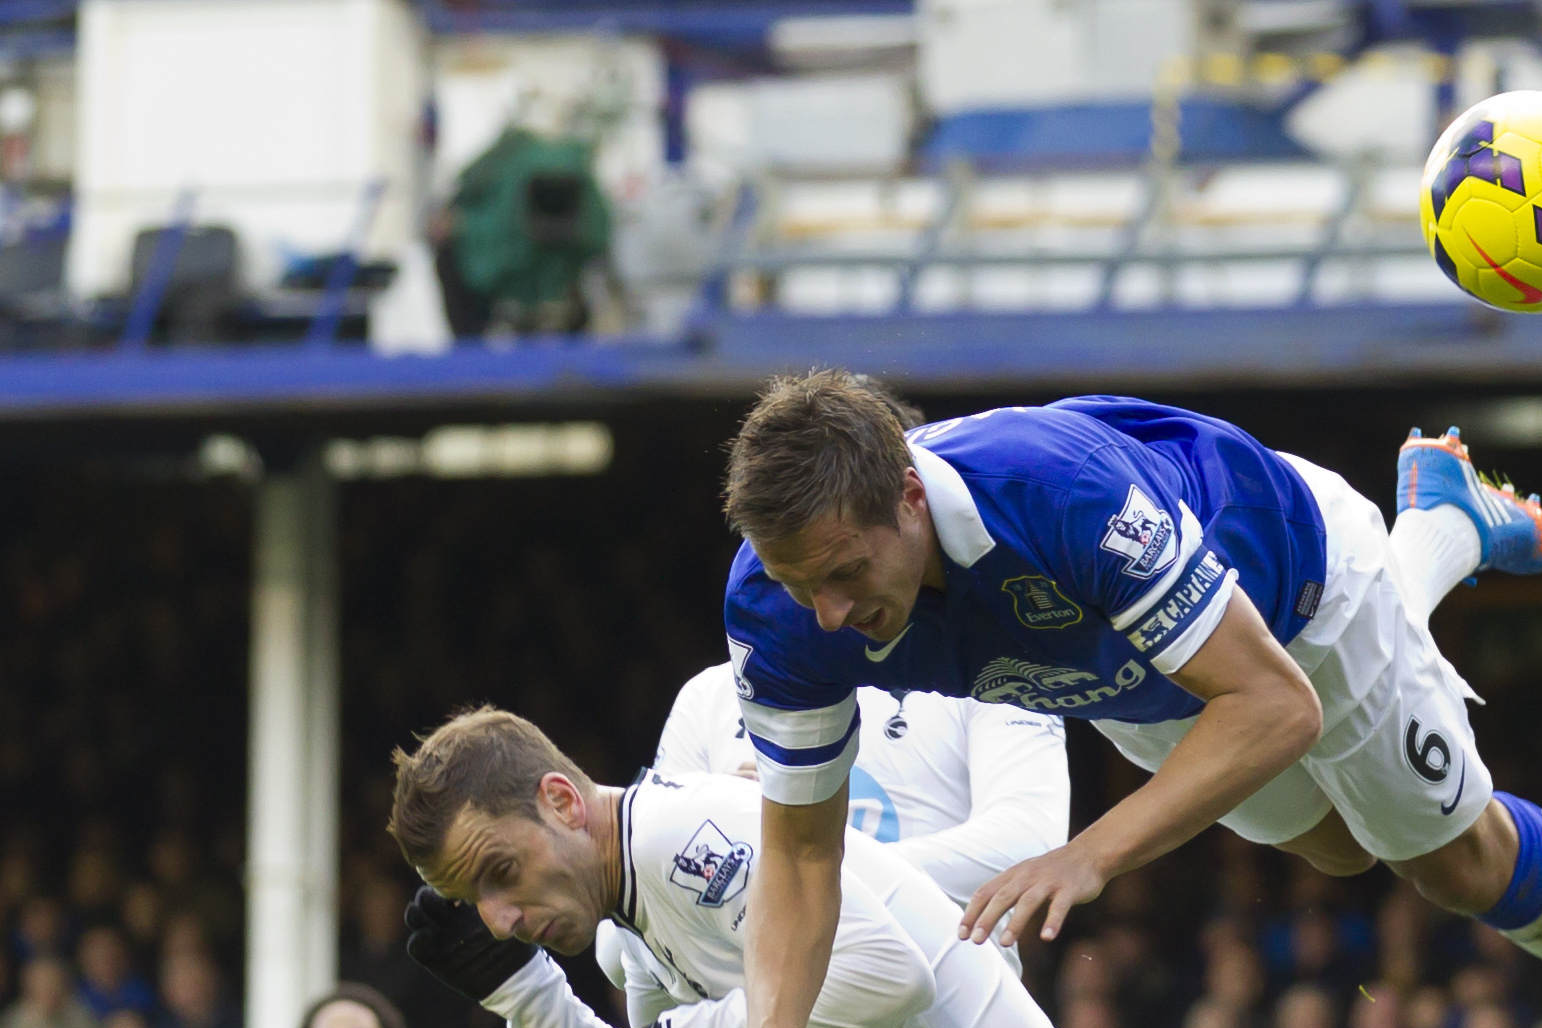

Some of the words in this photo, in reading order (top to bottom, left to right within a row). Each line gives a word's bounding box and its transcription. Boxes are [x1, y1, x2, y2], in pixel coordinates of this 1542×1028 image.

[1139, 527, 1167, 568] BARCLAYS
[1161, 560, 1219, 622] CAPTAIN
[1026, 608, 1075, 622] Everton
[1020, 659, 1146, 709] hang
[1403, 714, 1451, 785] 6
[707, 859, 734, 899] BARCLAYS
